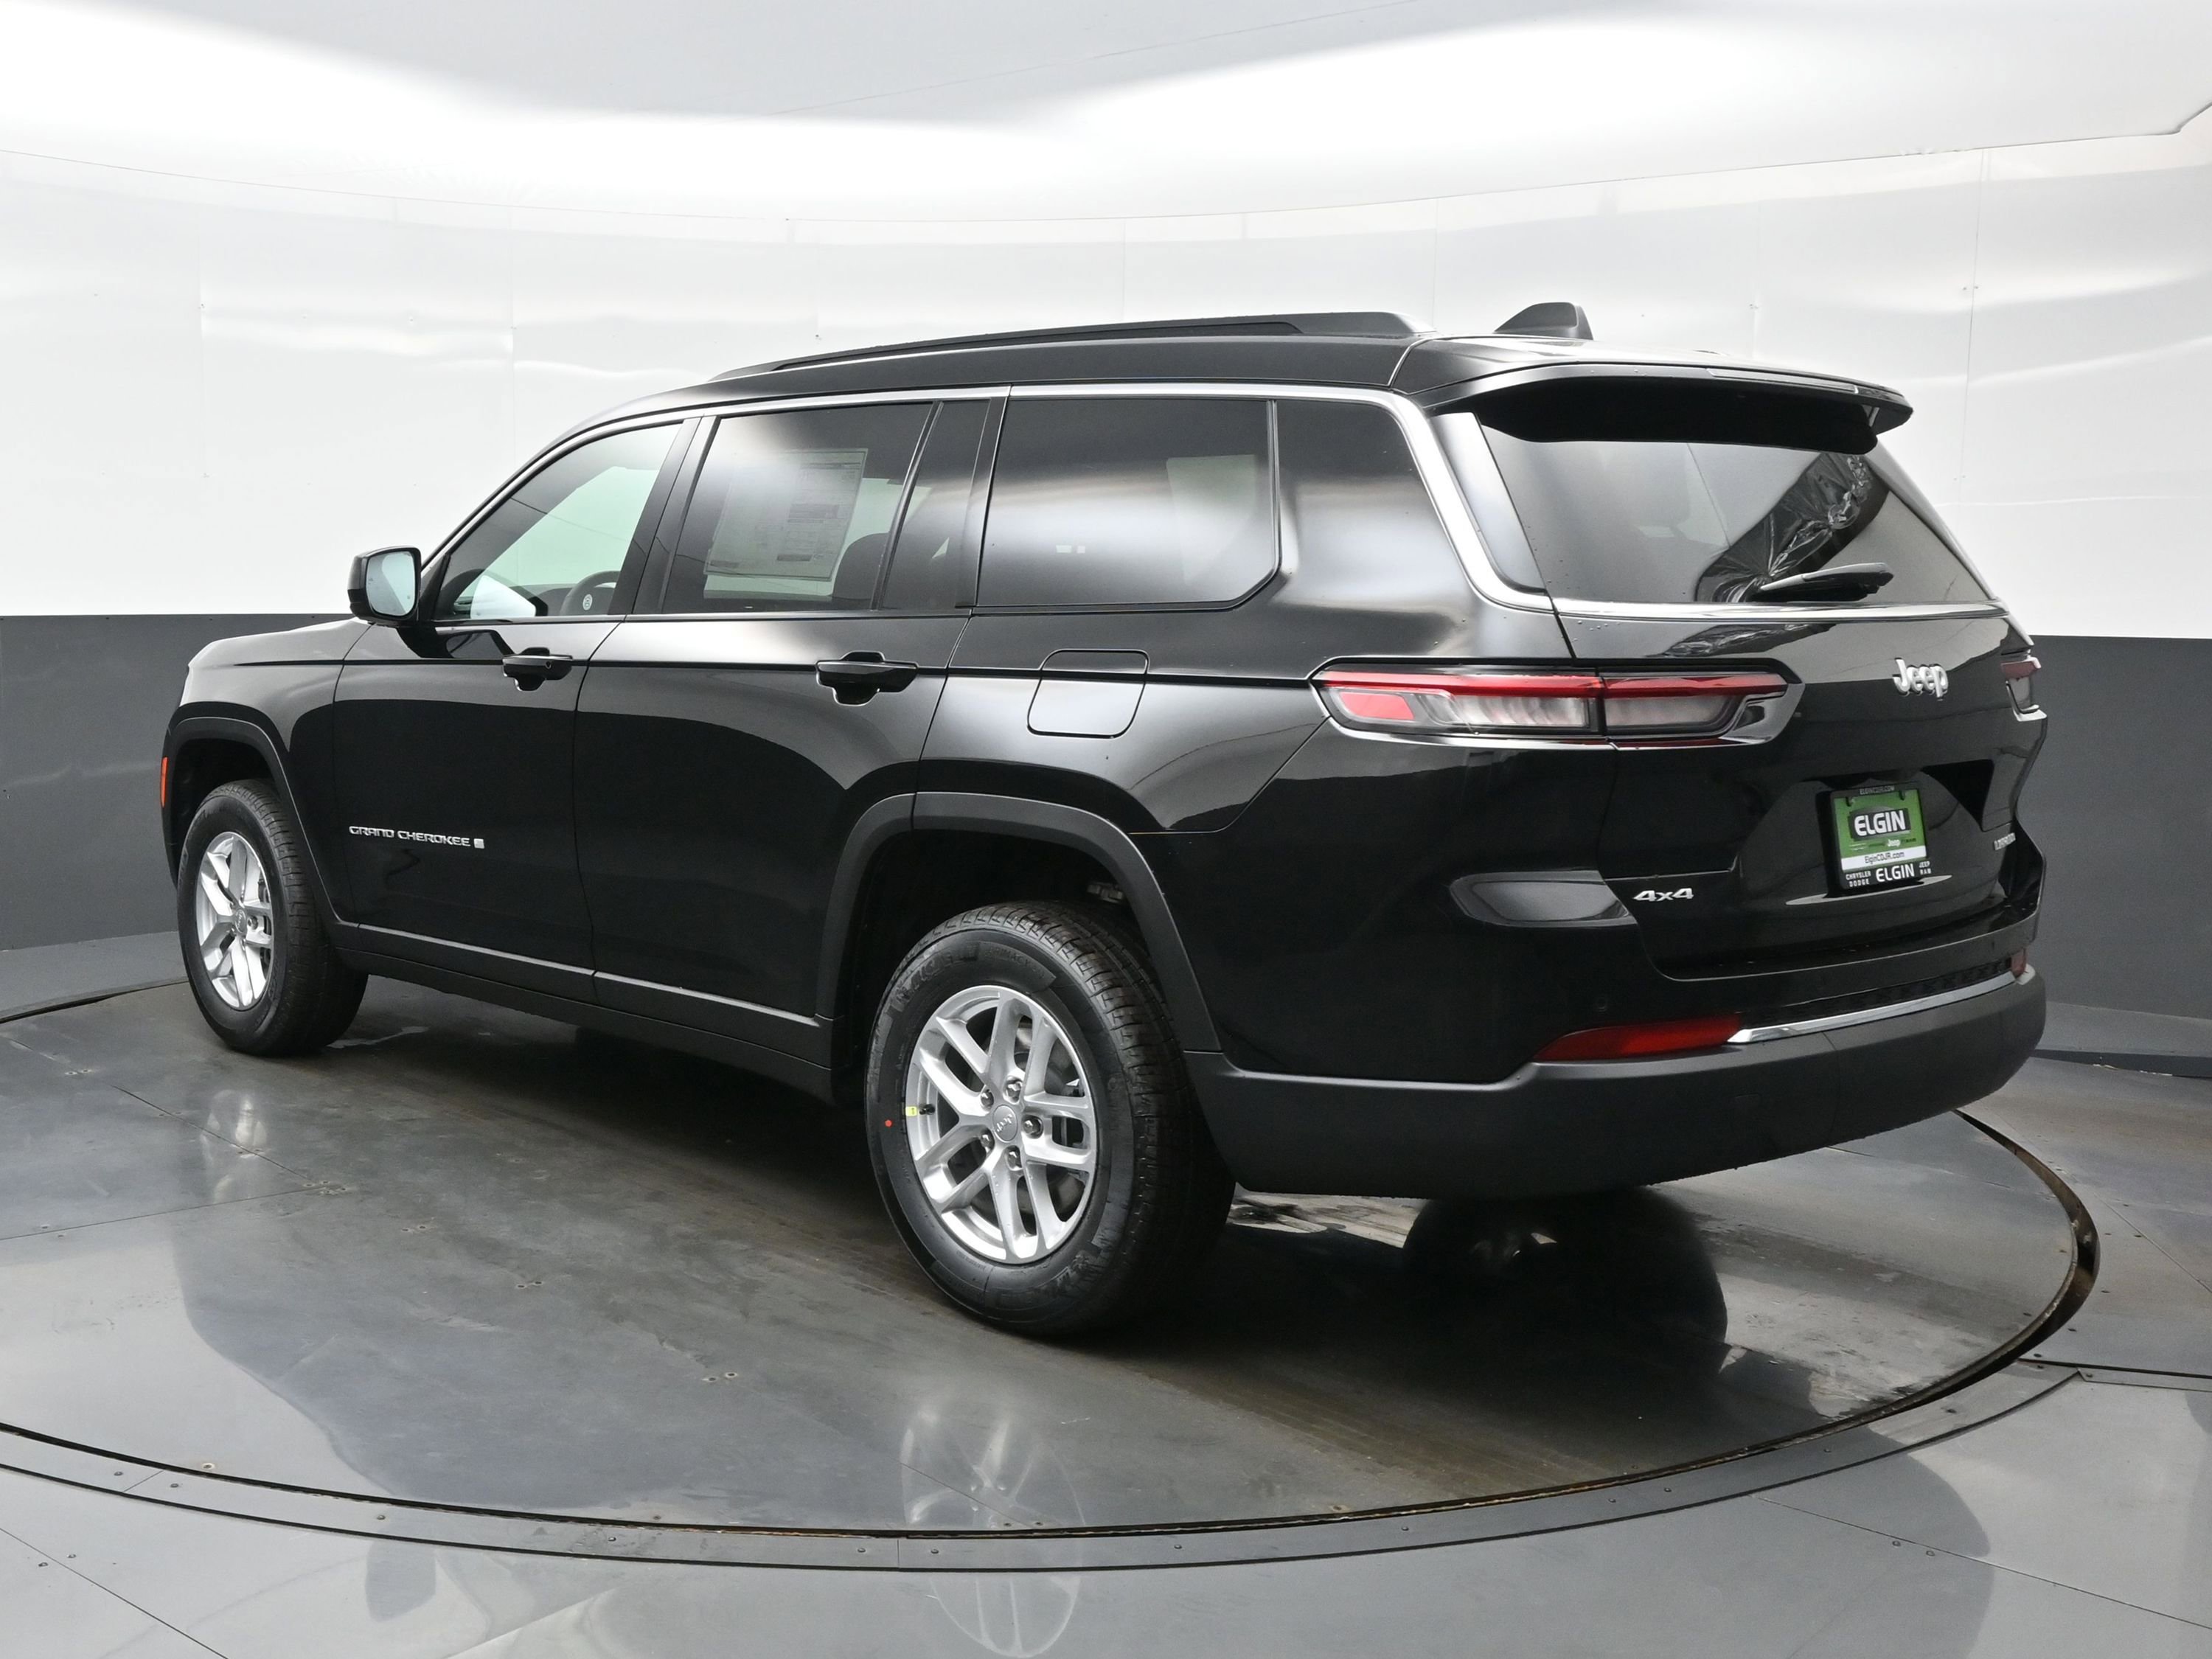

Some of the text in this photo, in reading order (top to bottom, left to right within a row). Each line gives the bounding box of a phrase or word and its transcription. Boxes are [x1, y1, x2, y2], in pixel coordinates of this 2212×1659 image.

[1892, 658, 1949, 700] Jeep
[1854, 810, 1906, 837] ELGIN
[349, 826, 471, 846] GRAND CHEROKEE
[1846, 871, 1871, 881] CHRYSLER
[1876, 863, 1915, 883] ELGIN
[1848, 878, 1870, 888] DODGE
[1632, 888, 1694, 902] 4x4
